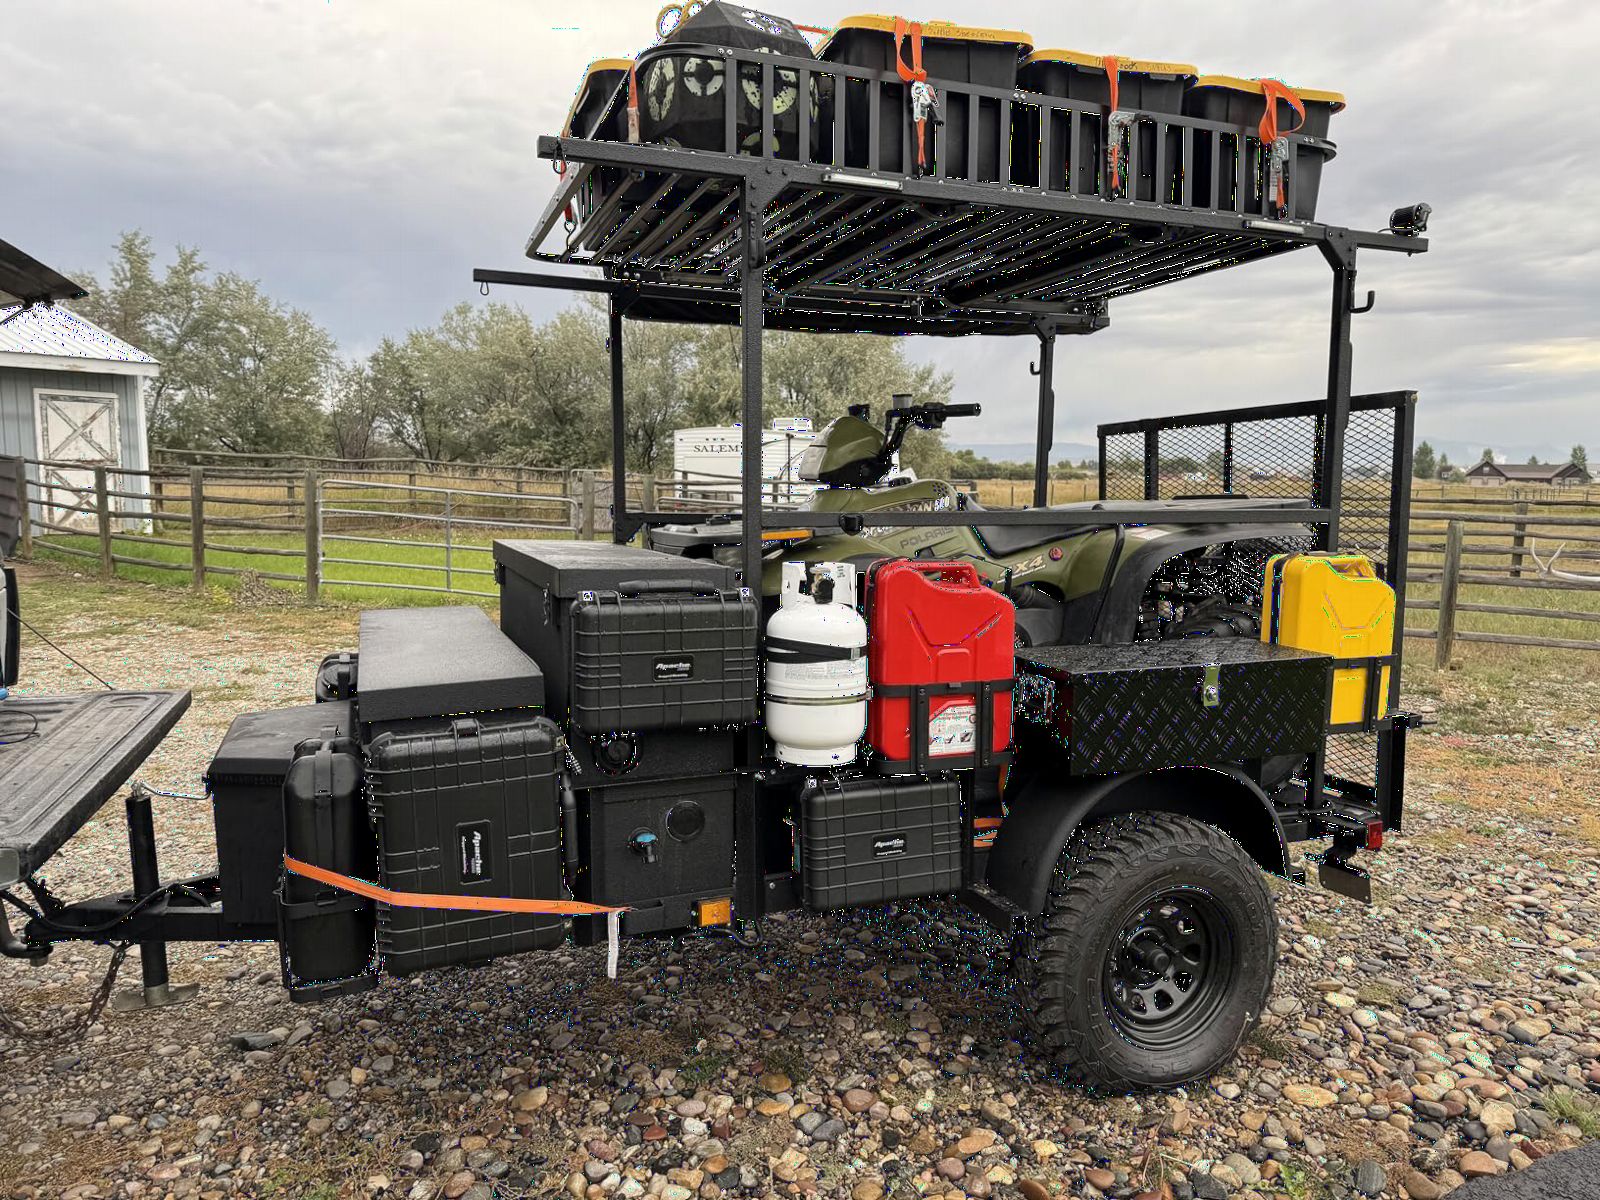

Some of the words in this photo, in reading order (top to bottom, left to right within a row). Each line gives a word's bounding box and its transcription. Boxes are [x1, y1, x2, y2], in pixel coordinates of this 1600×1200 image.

[693, 444, 740, 453] SALEM
[899, 525, 955, 549] POLARIS
[655, 662, 691, 671] Apache
[472, 830, 483, 875] Apache
